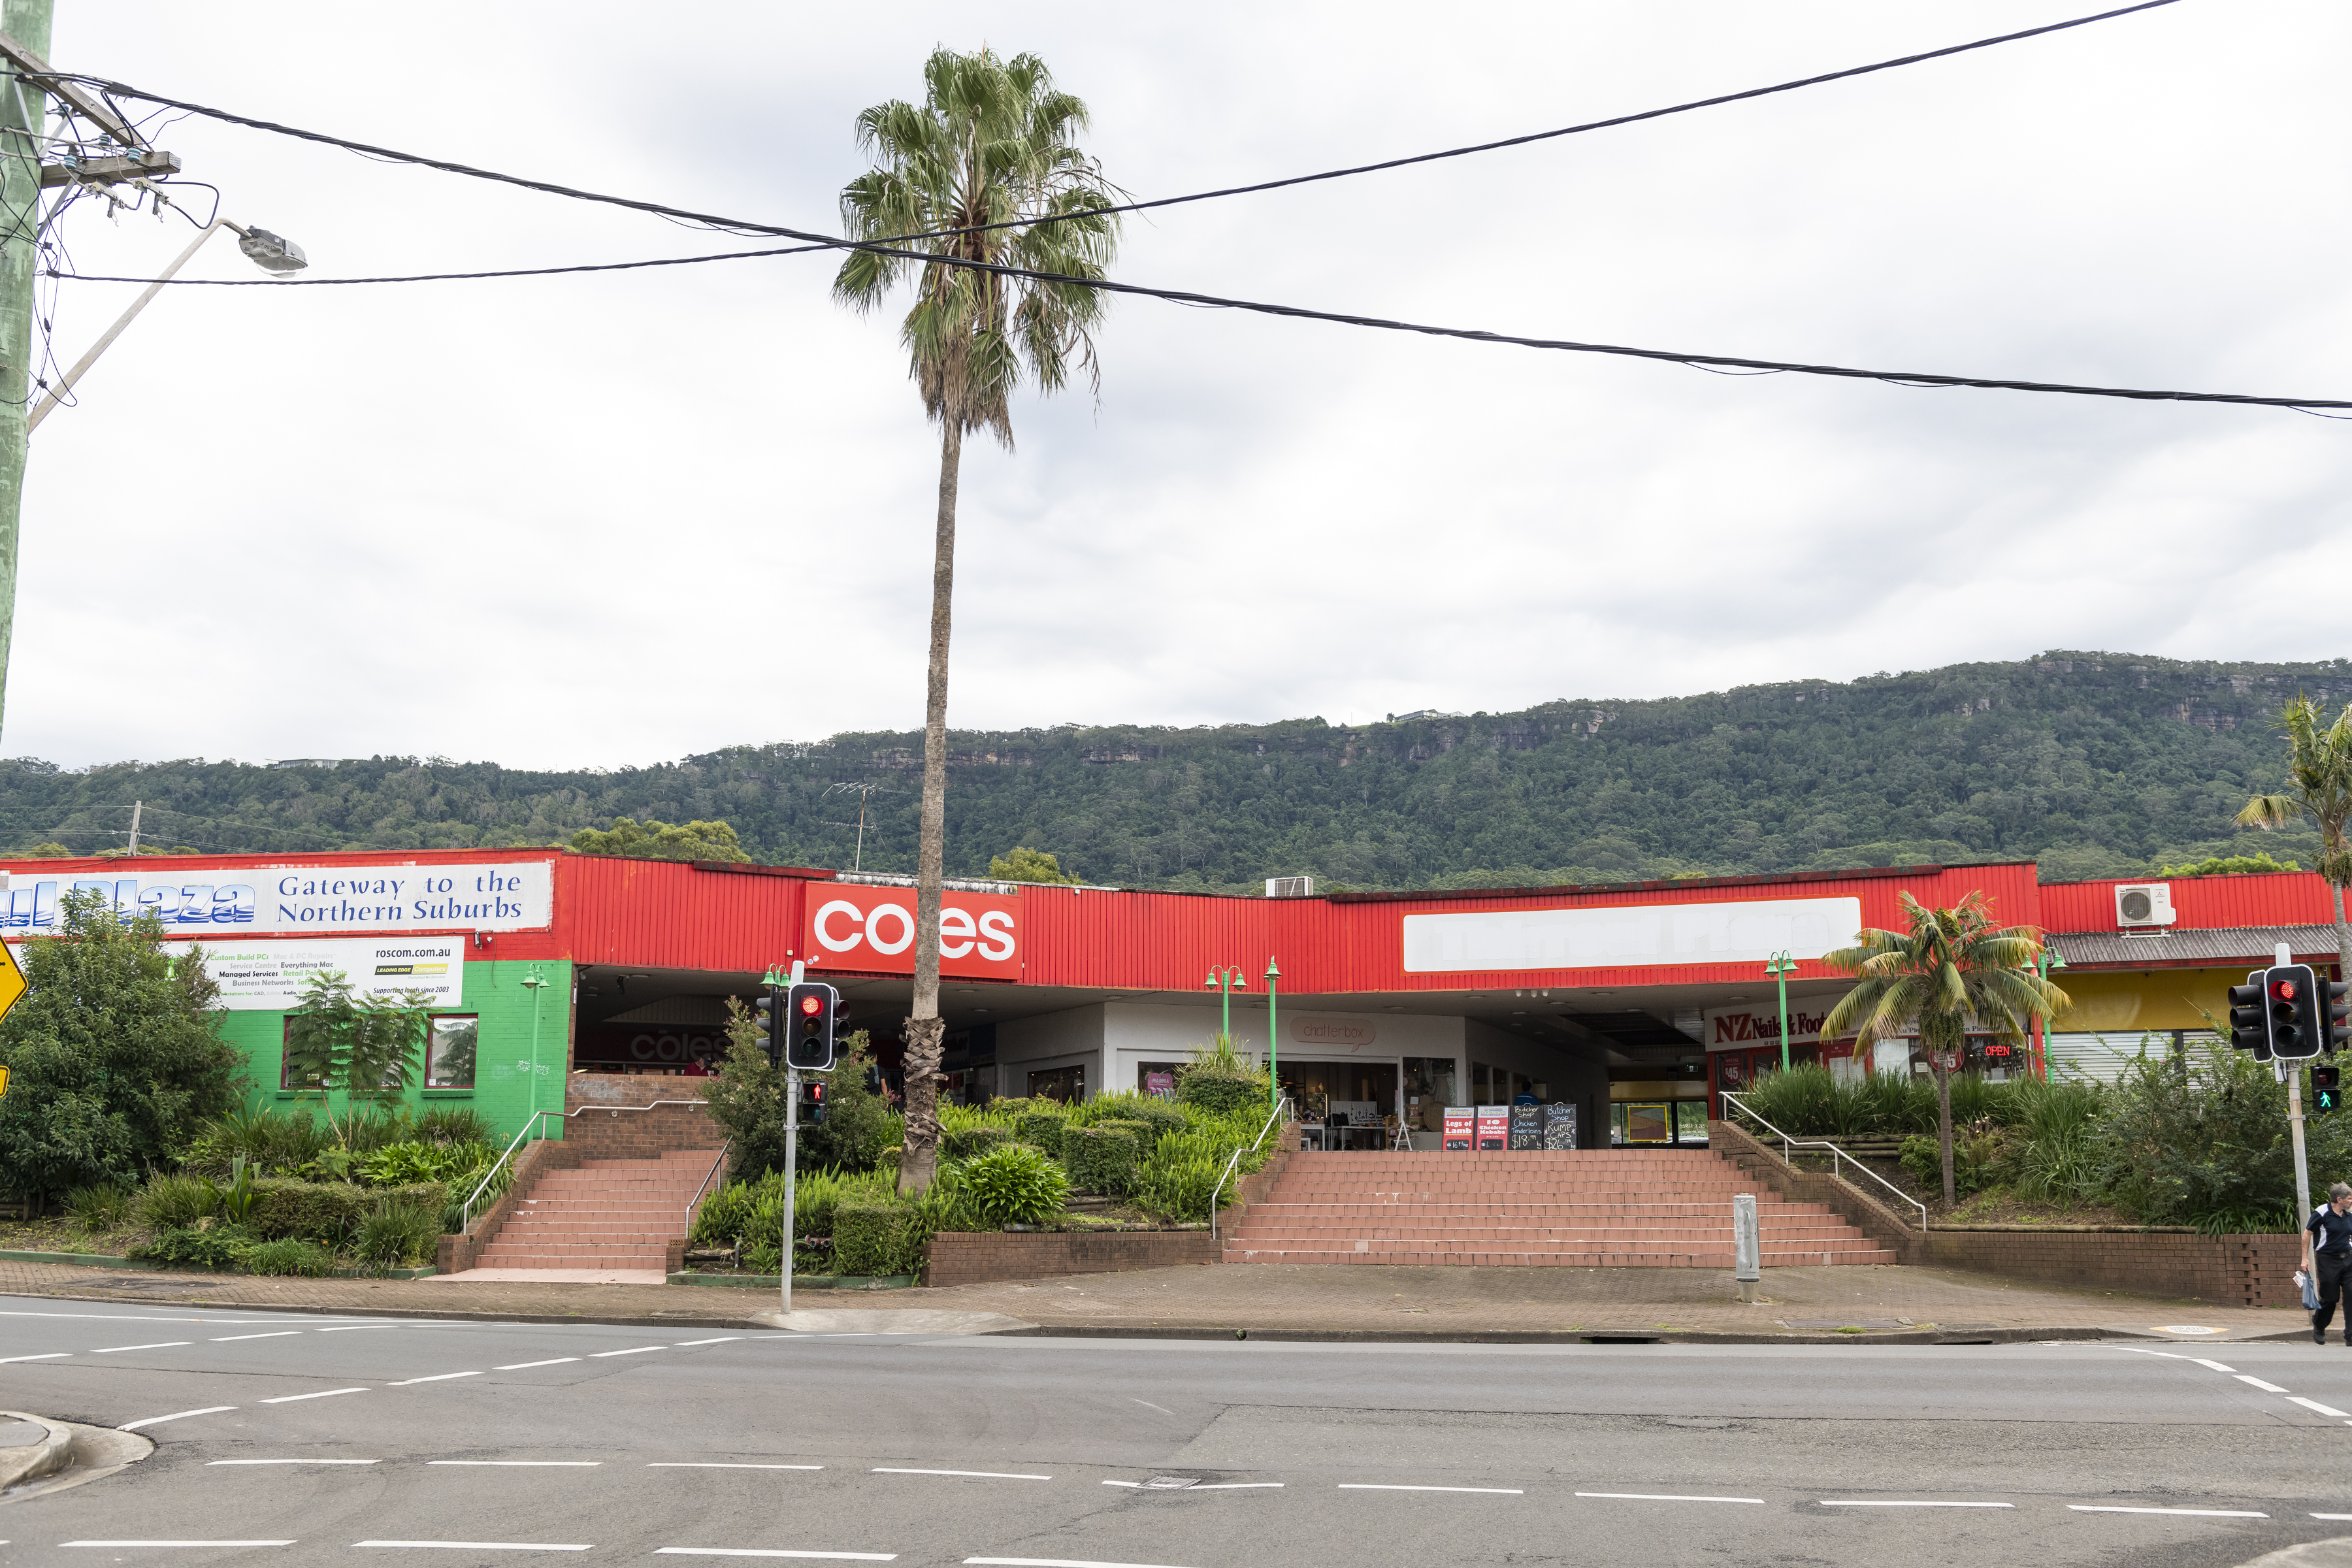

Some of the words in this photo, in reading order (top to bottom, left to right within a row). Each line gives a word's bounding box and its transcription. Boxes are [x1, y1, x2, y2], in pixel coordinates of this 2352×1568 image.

[278, 876, 404, 900] Gateway
[426, 877, 453, 893] to
[476, 870, 521, 892] the
[73, 879, 255, 925] Plaza
[276, 899, 403, 923] Northern
[413, 896, 522, 919] Suburbs
[814, 900, 1015, 961] coes
[376, 949, 451, 958] roscom.com.au
[280, 961, 318, 970] Everything
[1303, 1023, 1364, 1038] chatterbox
[1714, 1013, 1752, 1043] NZ
[1751, 1015, 1782, 1039] Nails
[1786, 1013, 1796, 1036] &
[630, 1033, 734, 1062] coles
[1985, 1045, 2010, 1056] OPEN
[1934, 1054, 1956, 1068] $5
[1725, 1066, 1739, 1080] $45
[1547, 1105, 1573, 1115] Butcher
[1513, 1119, 1537, 1127] Chicken
[1537, 1140, 1542, 1149] kg
